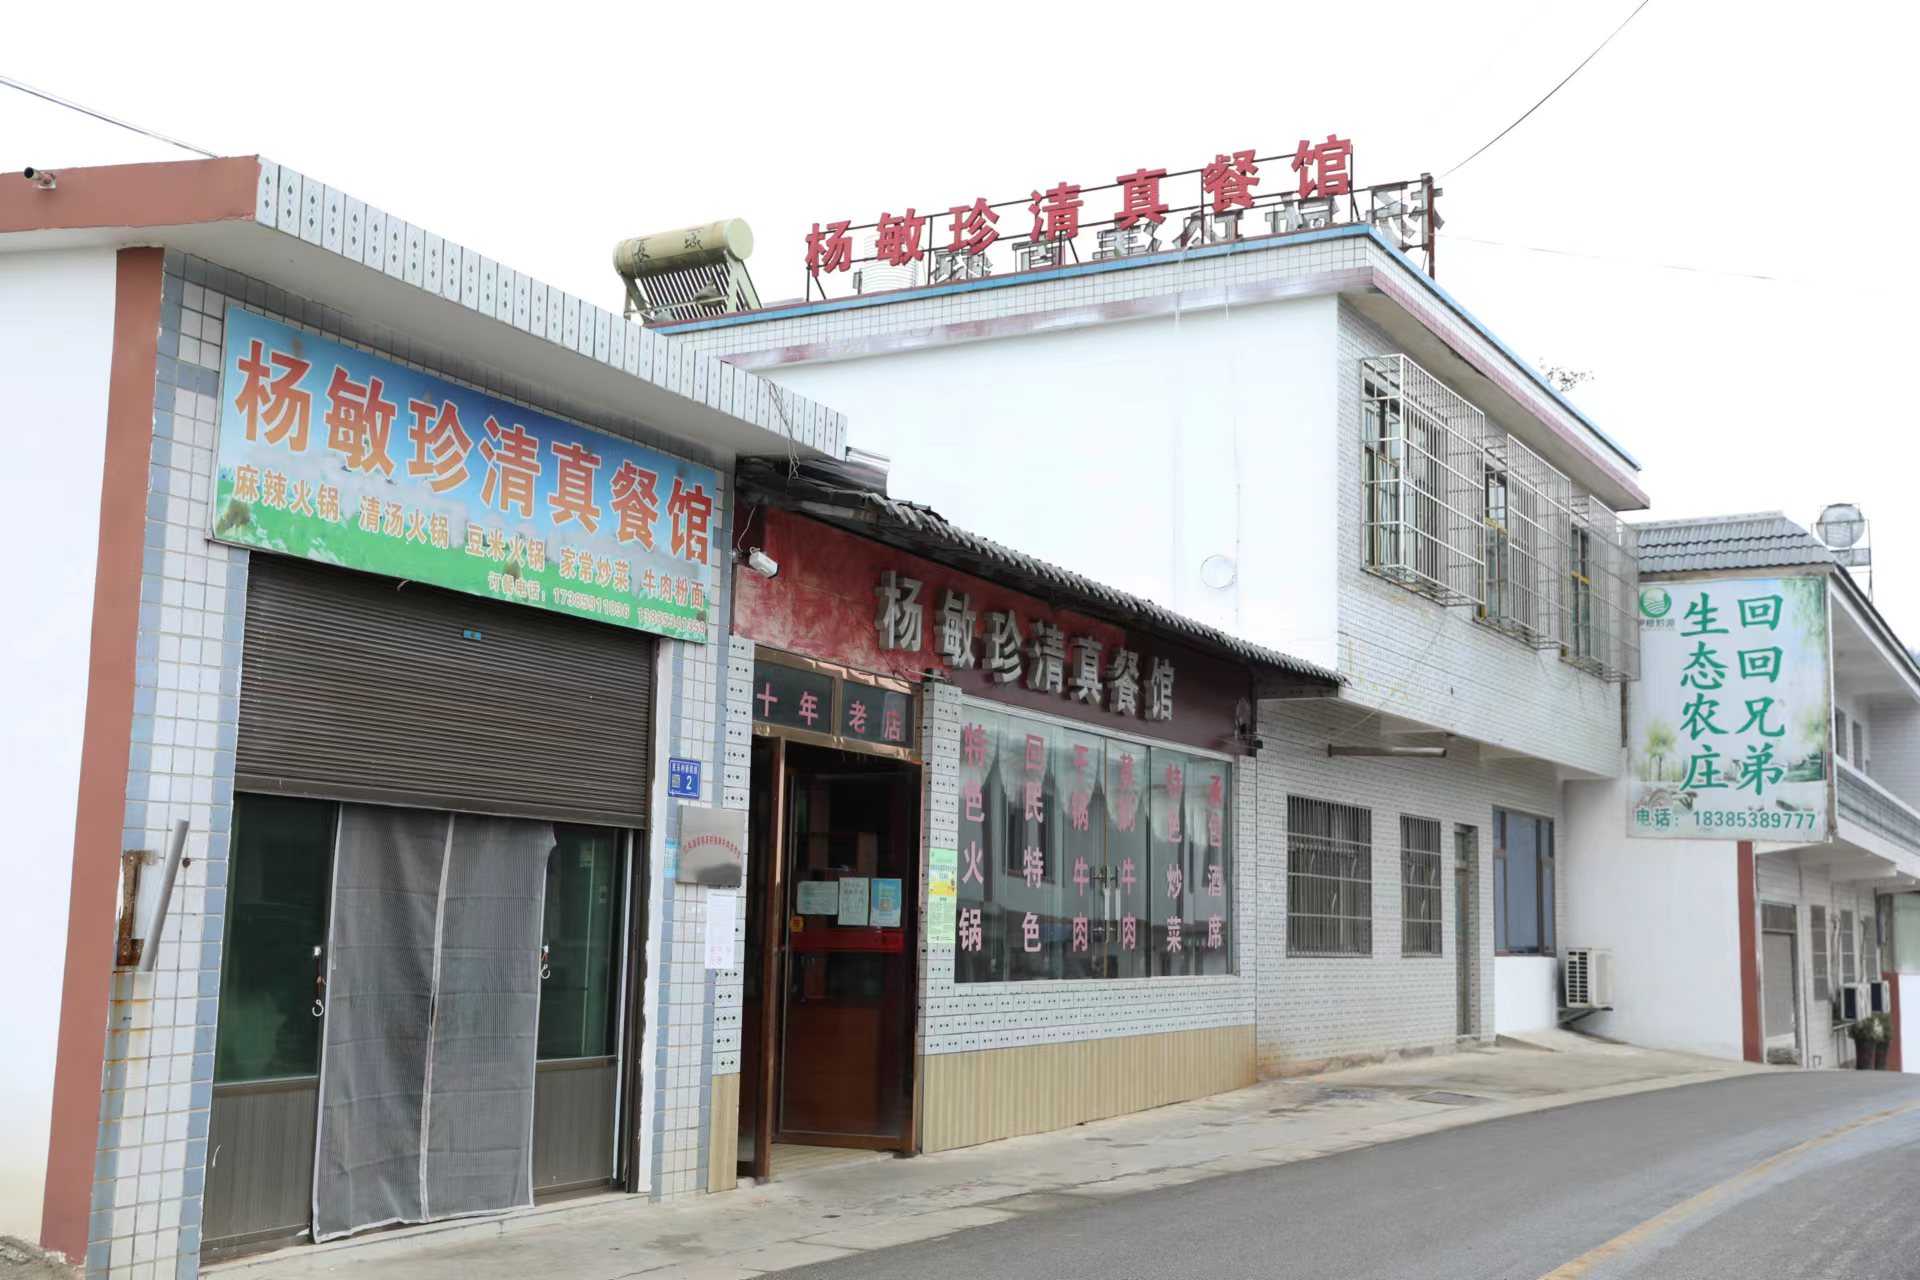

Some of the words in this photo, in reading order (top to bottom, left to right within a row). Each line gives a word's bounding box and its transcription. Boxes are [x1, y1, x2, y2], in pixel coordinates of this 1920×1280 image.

[805, 134, 1353, 276] 杨敏珍清真餐馆
[233, 463, 341, 523] 麻辣火锅
[358, 494, 450, 549] 清汤火锅
[465, 524, 546, 573] 豆米火锅
[559, 546, 632, 593] 家常炒菜
[642, 568, 706, 610] 牛肉粉面
[234, 339, 714, 566] 杨敏珍清真餐馆
[757, 682, 901, 741] 十年老店
[875, 570, 1176, 721] 杨敏珍清真餐馆
[1680, 592, 1730, 791] 生态农庄
[1735, 594, 1786, 796] 回回兄弟
[686, 775, 693, 790] 2
[959, 722, 989, 952] 特色火锅
[1021, 733, 1045, 953] 回民特色
[1165, 763, 1183, 953] 特色炒菜
[1693, 809, 1817, 830] 18385389777
